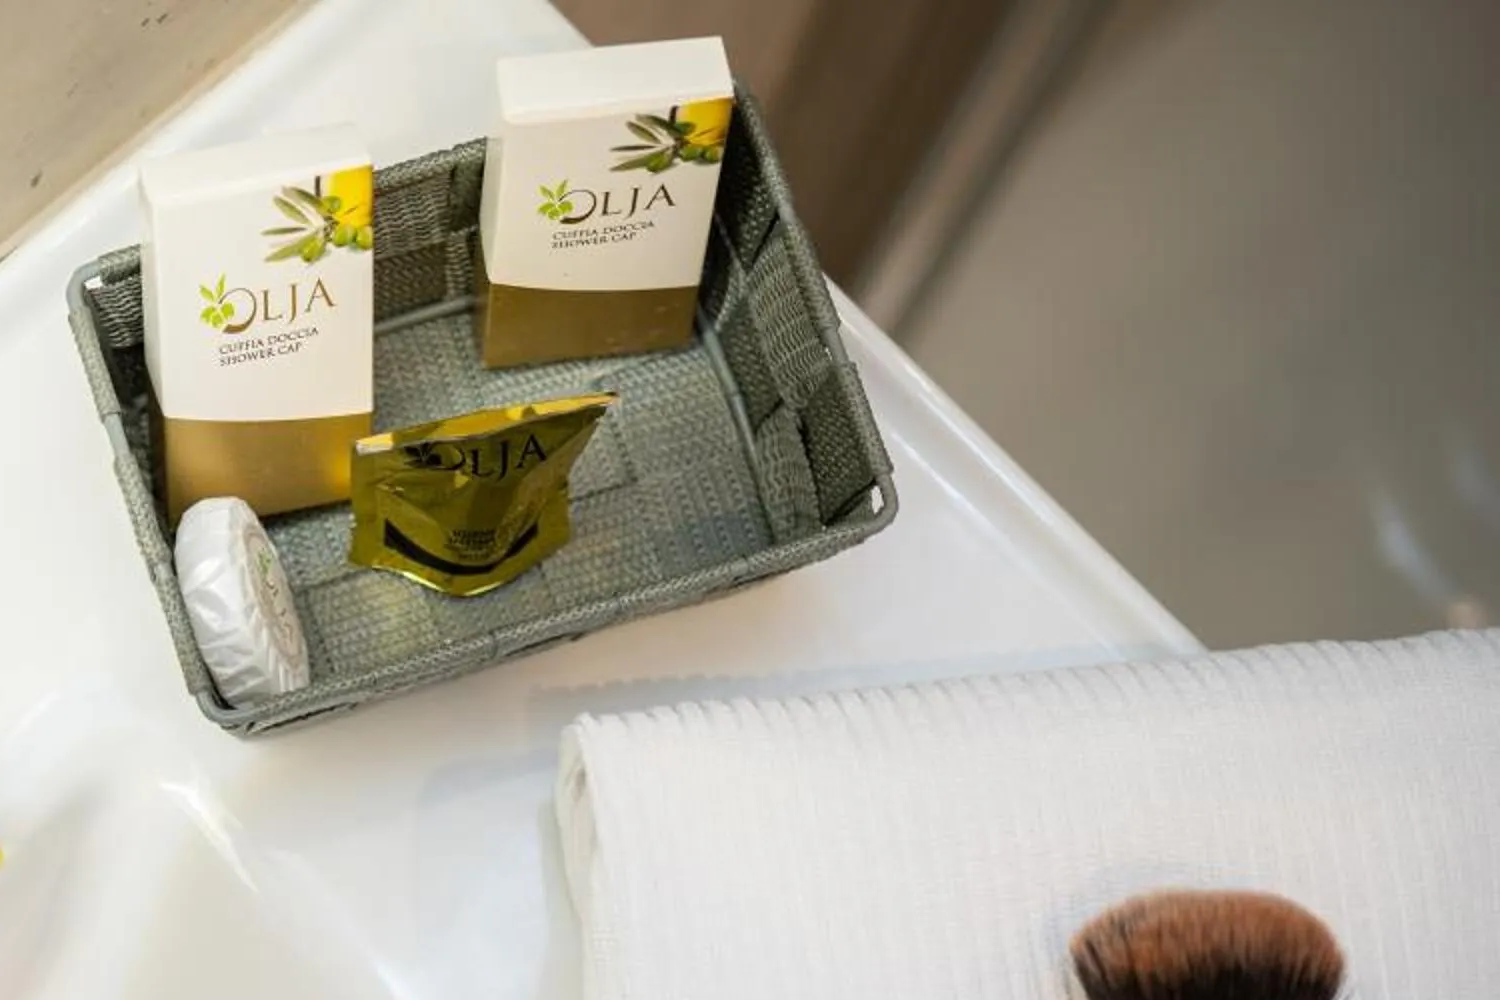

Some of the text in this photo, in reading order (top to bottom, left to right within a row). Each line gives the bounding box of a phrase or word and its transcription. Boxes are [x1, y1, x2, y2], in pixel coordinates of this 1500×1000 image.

[558, 183, 676, 225] OLJA
[551, 231, 638, 249] SHOWER CAP
[218, 277, 337, 334] OLJA
[219, 342, 302, 366] SHOWER CAP
